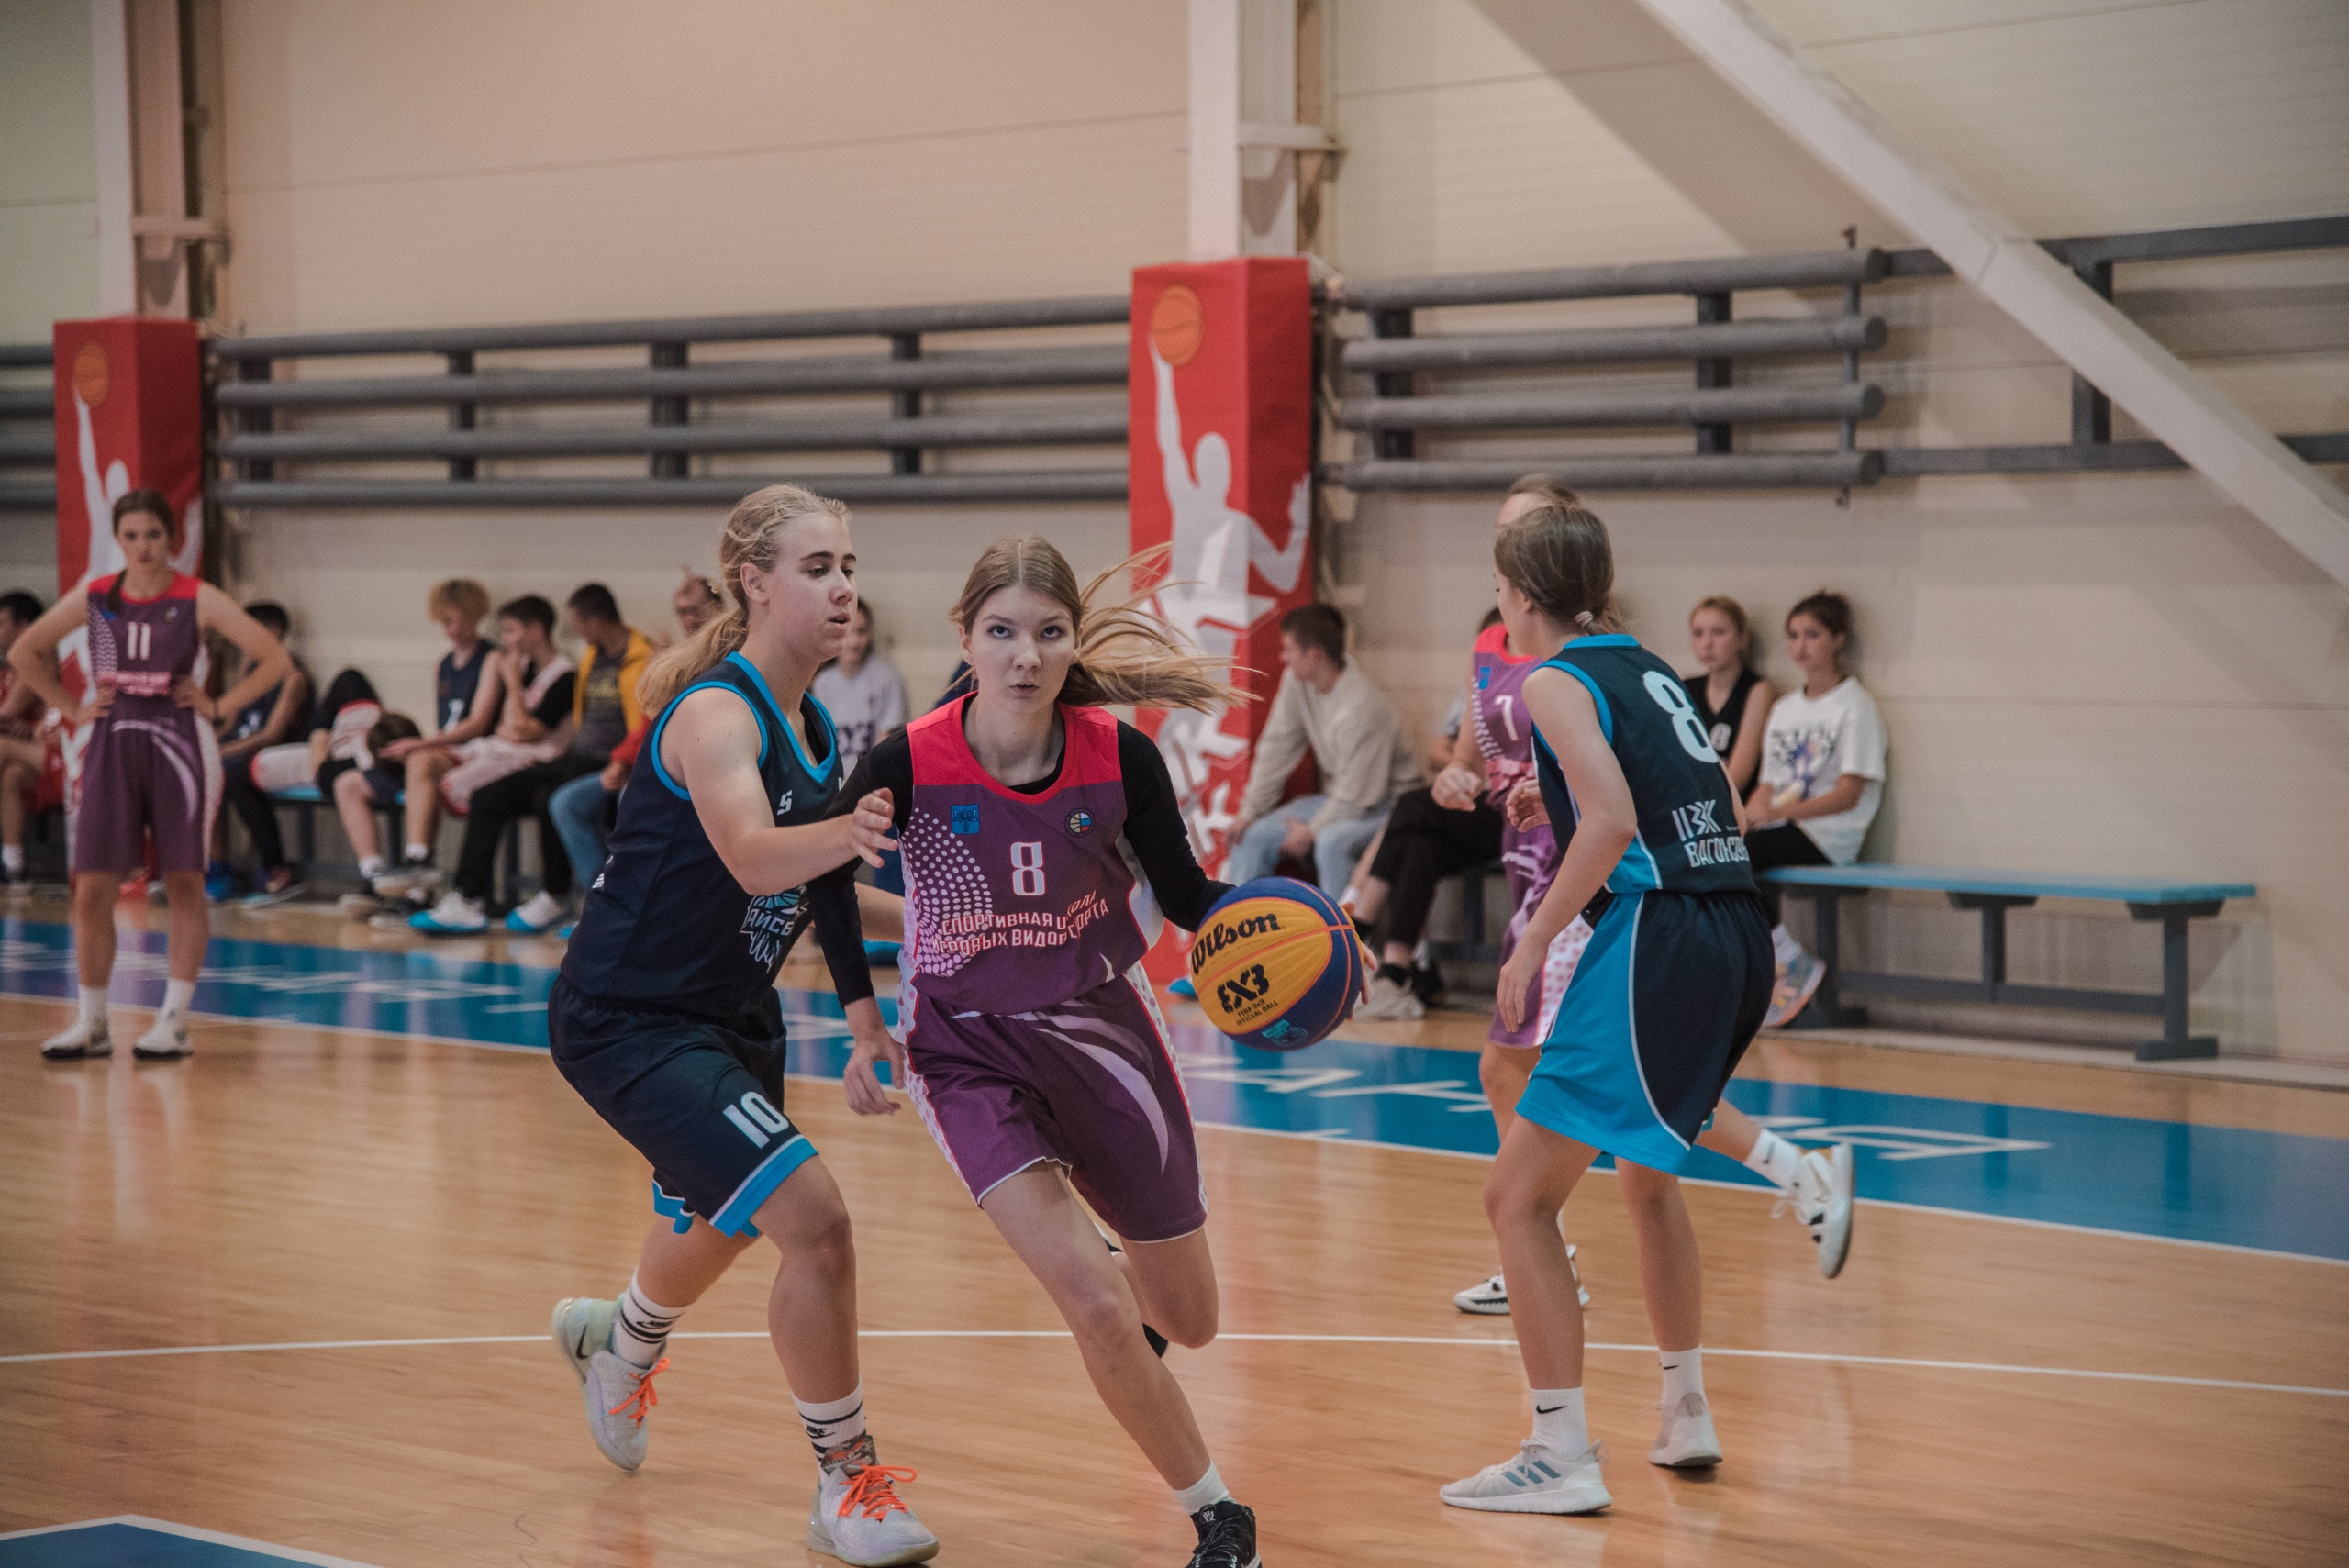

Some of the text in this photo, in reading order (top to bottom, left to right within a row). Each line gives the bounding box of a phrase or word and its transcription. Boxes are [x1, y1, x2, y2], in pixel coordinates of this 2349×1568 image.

[127, 621, 151, 661] 11
[1494, 695, 1520, 741] 7
[1642, 670, 1720, 763] 8
[1010, 841, 1046, 896] 8
[941, 889, 1096, 936] СПОРТИВНАЯ ШОЛА
[930, 931, 1008, 957] ИГРОВЫХ
[1011, 929, 1067, 948] ВИДОВ
[1191, 913, 1281, 976] Wilson
[722, 1091, 790, 1150] 10
